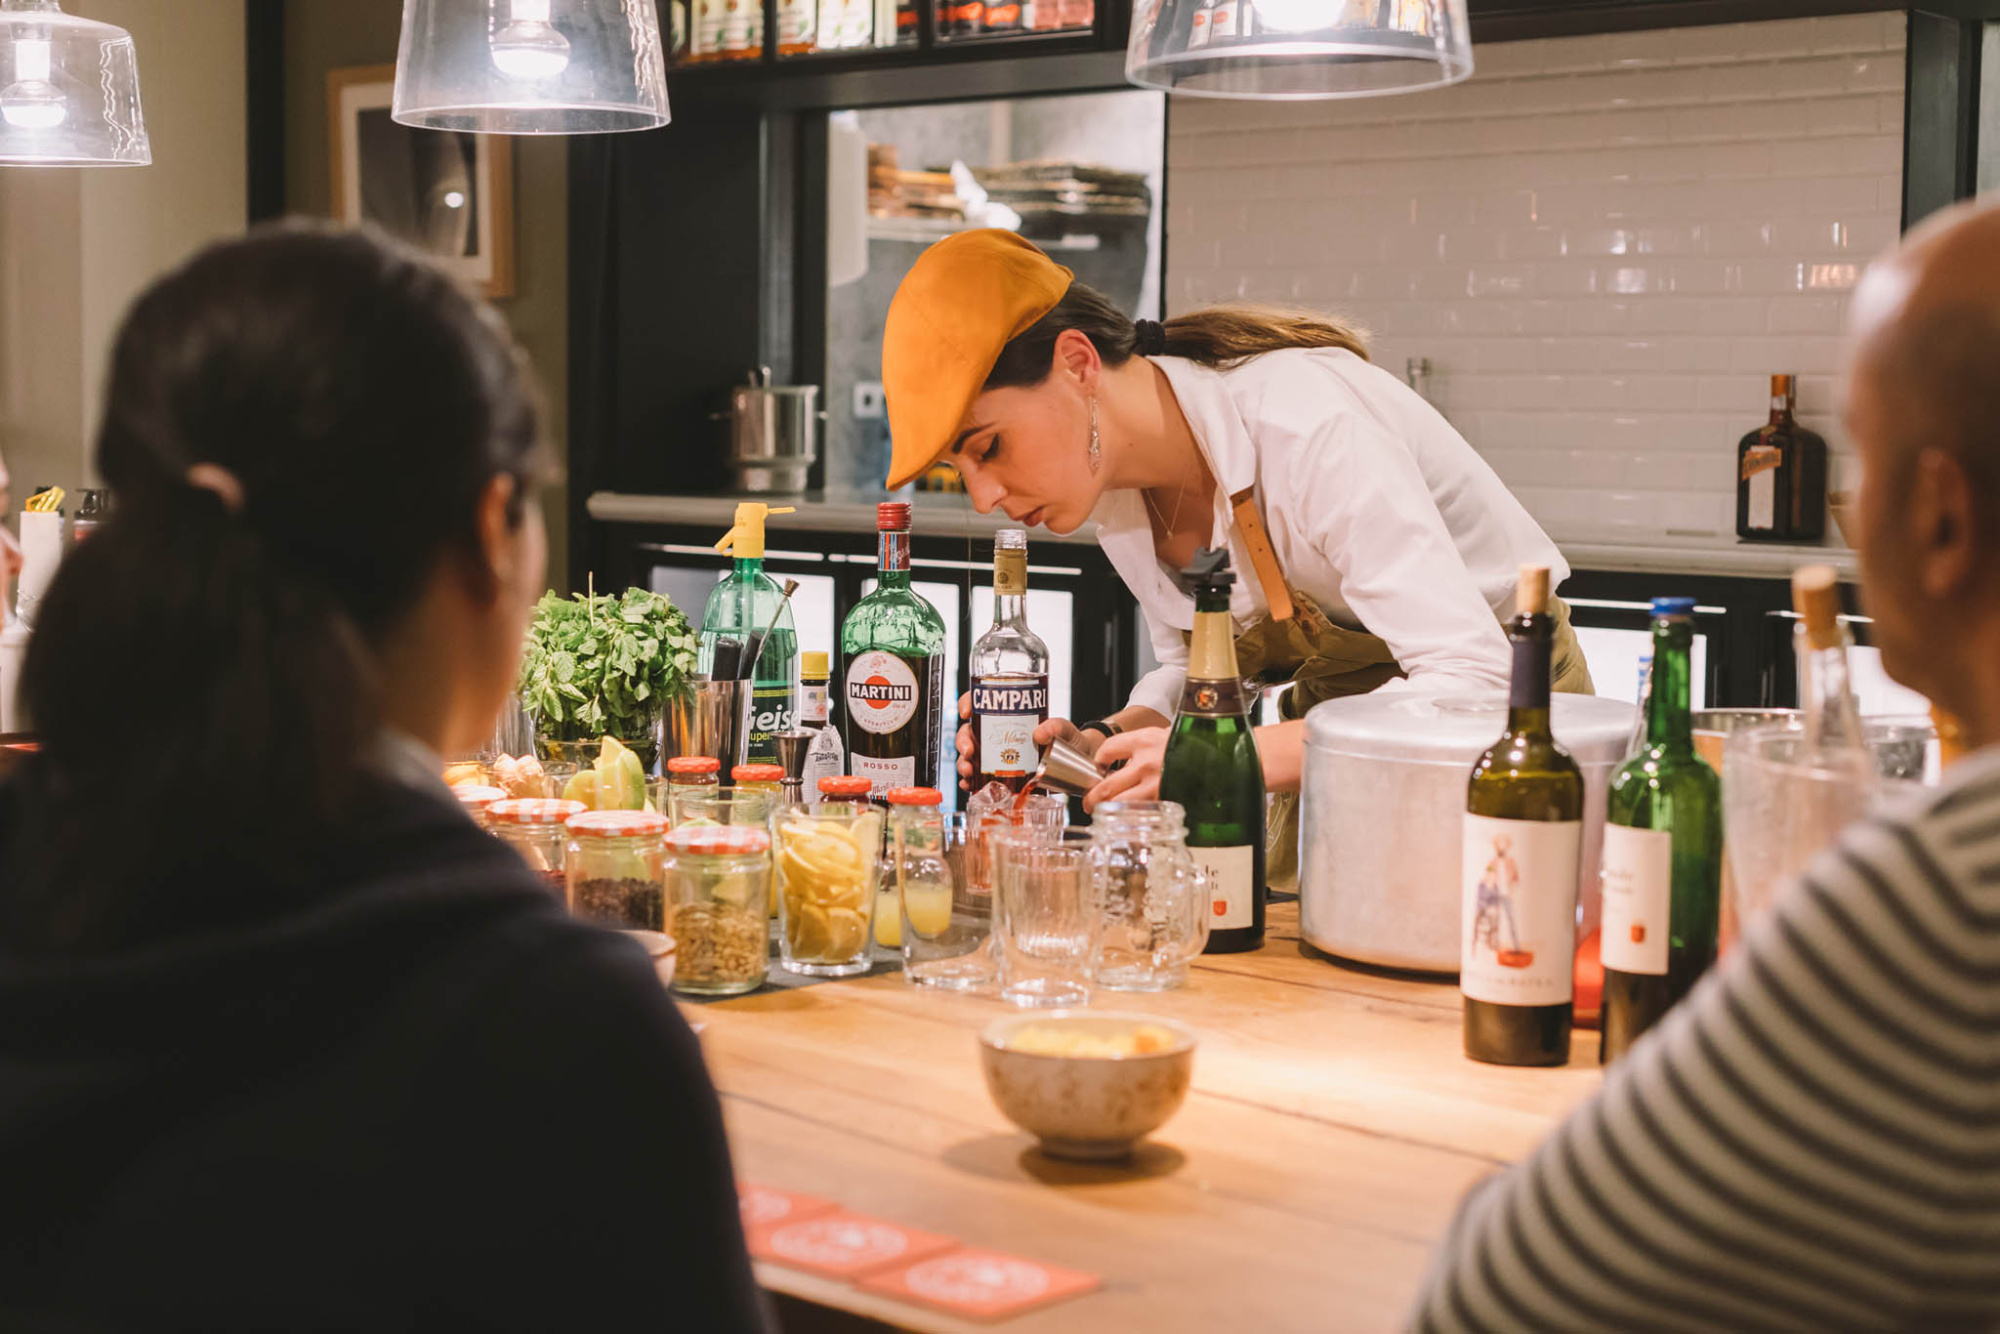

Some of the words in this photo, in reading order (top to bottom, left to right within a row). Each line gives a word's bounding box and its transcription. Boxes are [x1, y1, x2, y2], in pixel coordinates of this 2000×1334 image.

[851, 684, 910, 700] MARTINI
[973, 688, 1046, 710] CAMPARI
[863, 762, 898, 771] ROSSO
